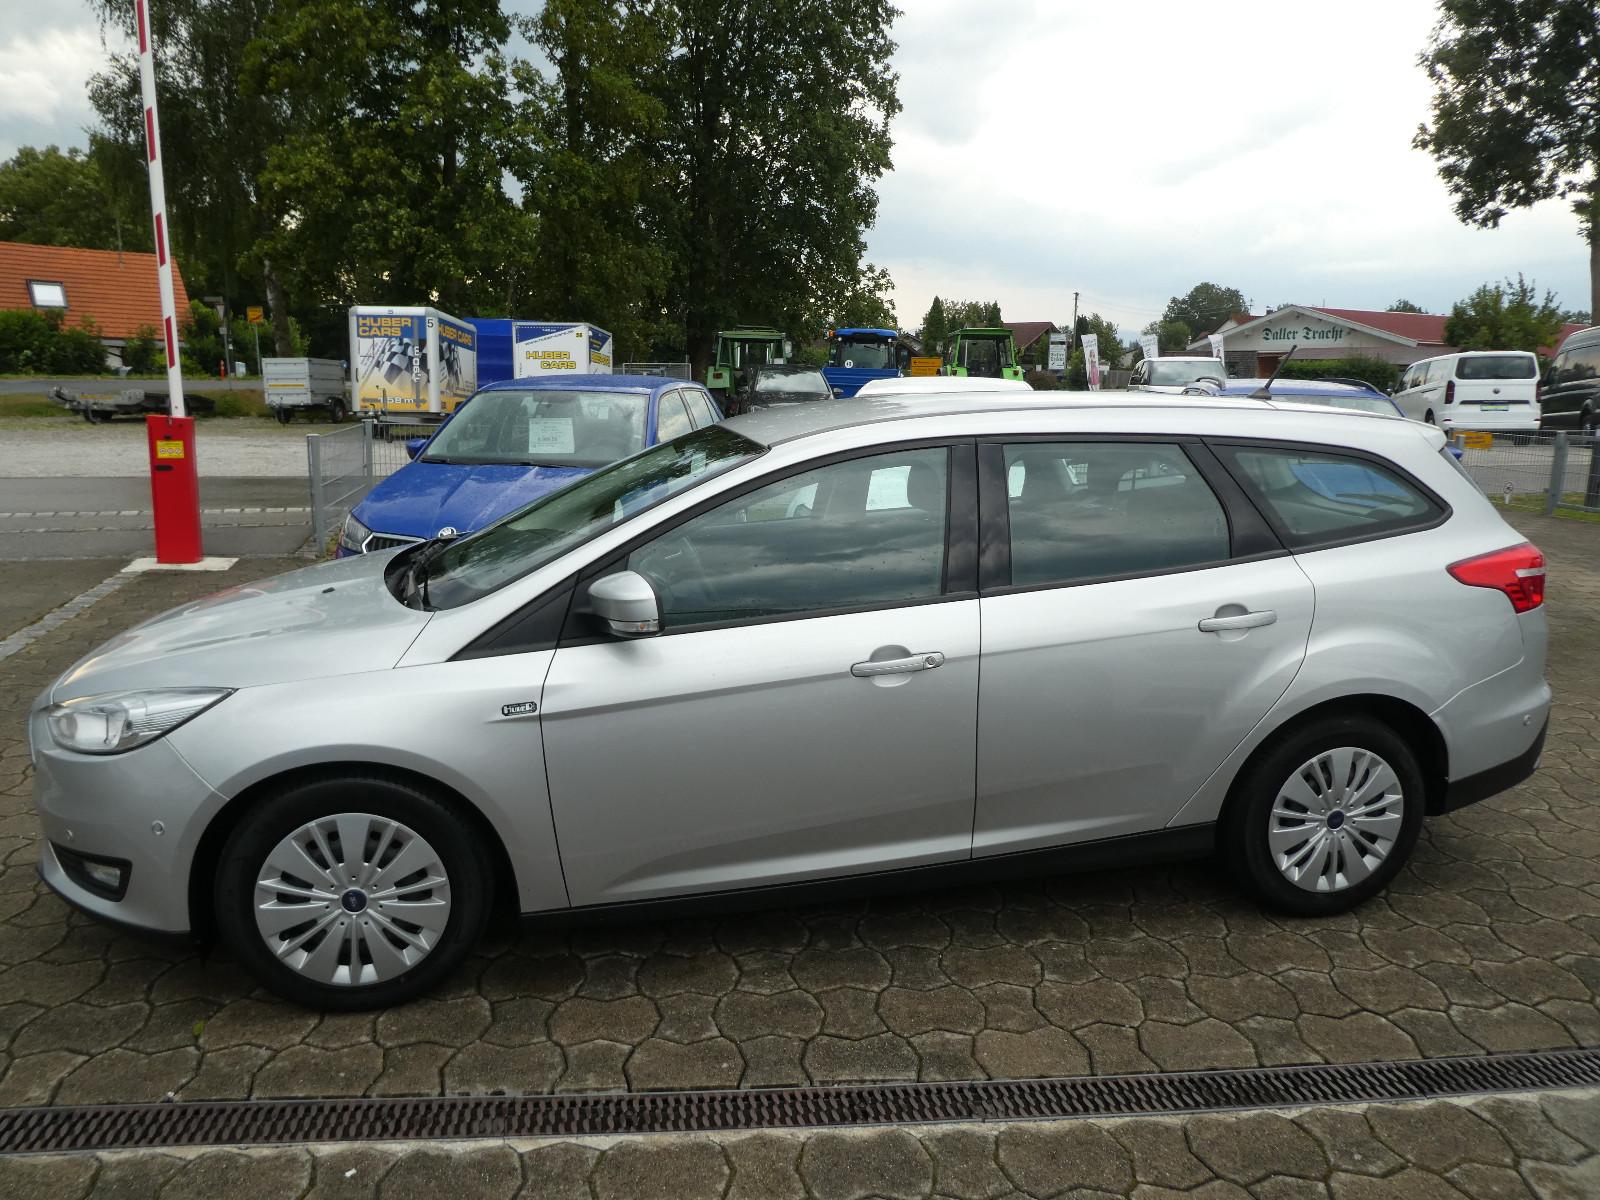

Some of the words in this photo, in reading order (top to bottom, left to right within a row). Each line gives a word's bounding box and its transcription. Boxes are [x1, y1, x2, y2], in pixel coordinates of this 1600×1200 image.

[359, 317, 412, 327] HUBER
[426, 318, 434, 328] 5
[359, 327, 402, 337] CARS
[1302, 326, 1344, 341] Tracht
[526, 351, 570, 359] HUBER
[541, 361, 577, 369] CARS
[378, 396, 402, 404] 158
